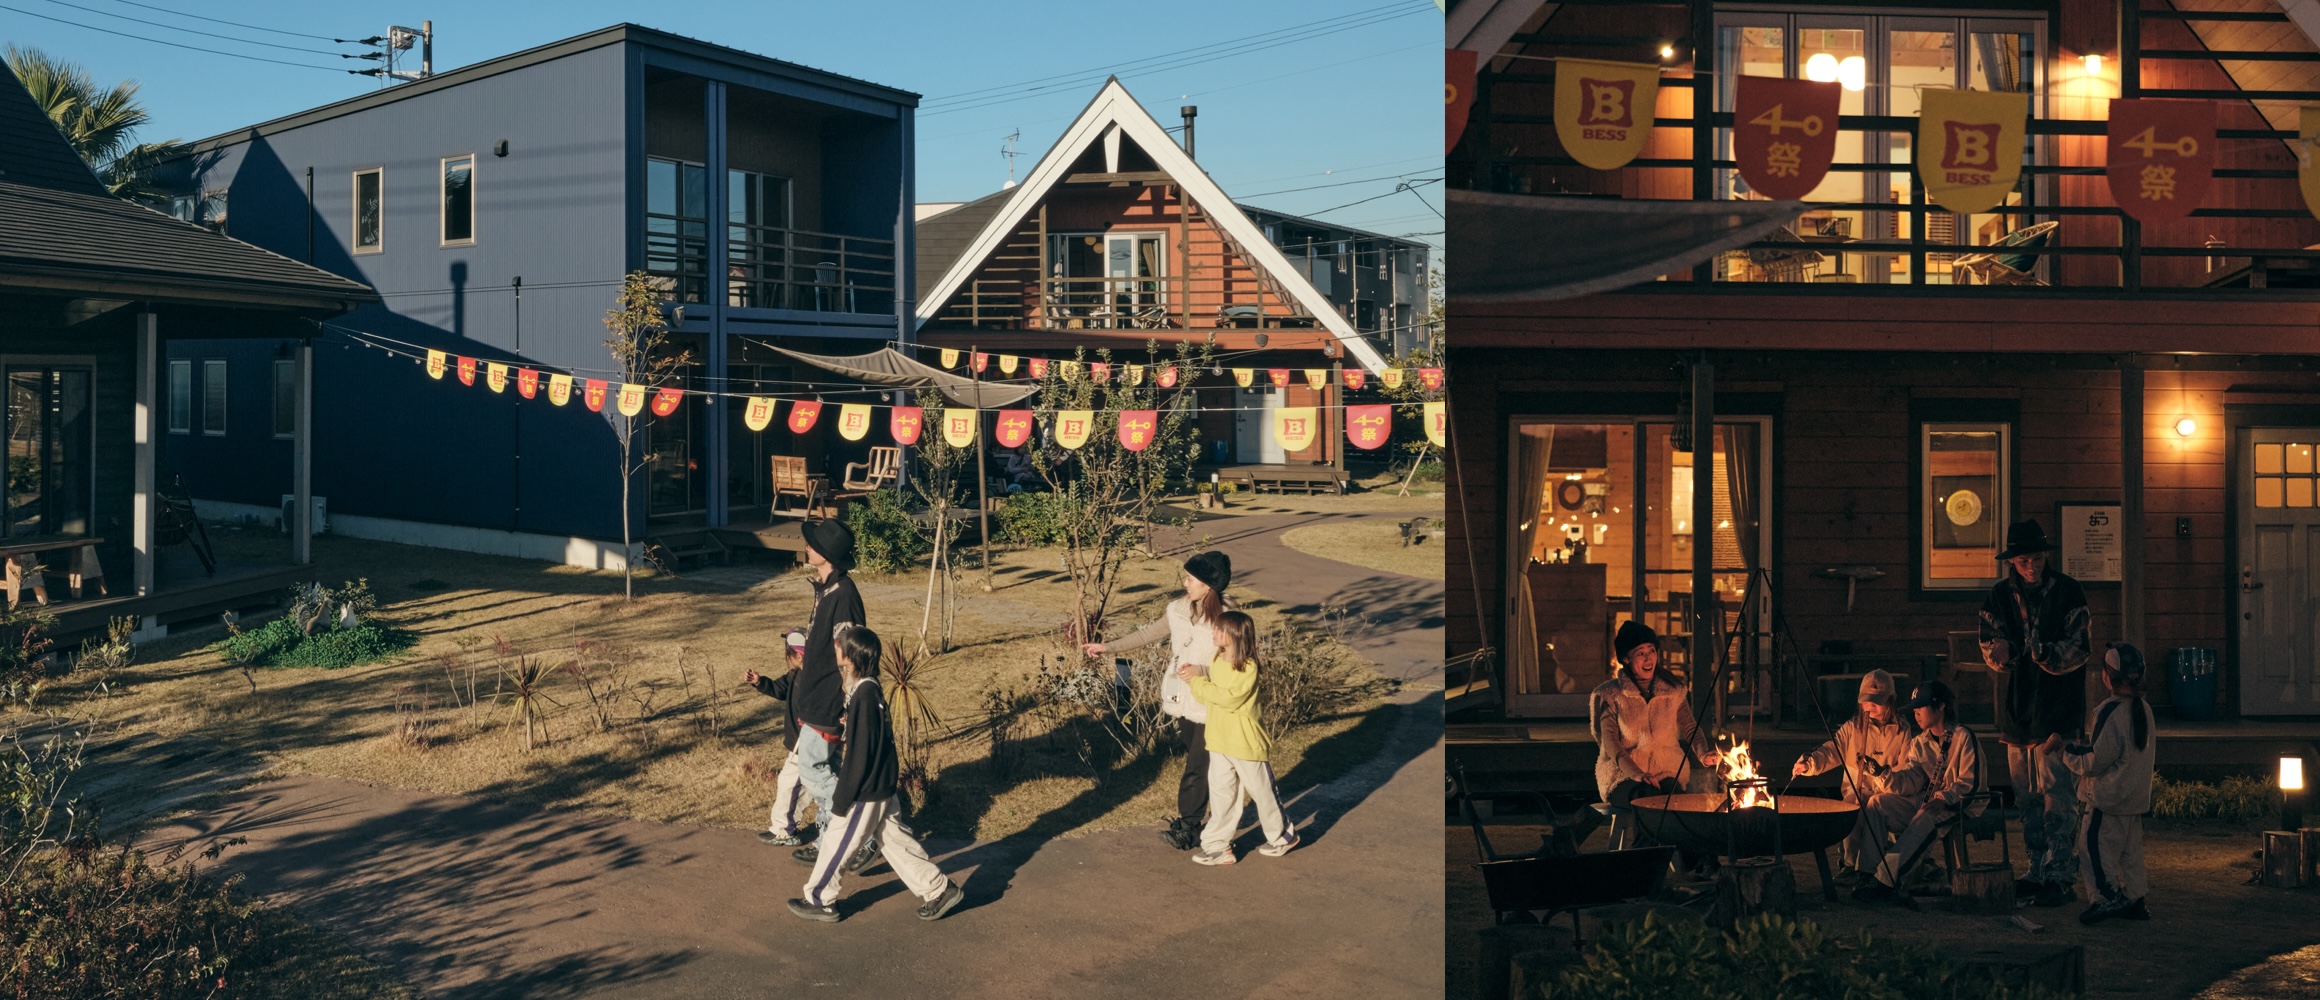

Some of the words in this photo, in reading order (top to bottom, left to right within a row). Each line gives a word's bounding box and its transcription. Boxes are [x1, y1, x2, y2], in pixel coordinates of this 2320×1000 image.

[1582, 127, 1627, 142] BESS
[1766, 141, 1803, 179] 祭
[1945, 172, 1992, 186] BESS
[2139, 165, 2175, 201] 祭
[901, 426, 912, 438] 祭
[1006, 428, 1019, 441] 祭
[1131, 431, 1144, 444] 祭
[1361, 427, 1376, 441] 祭
